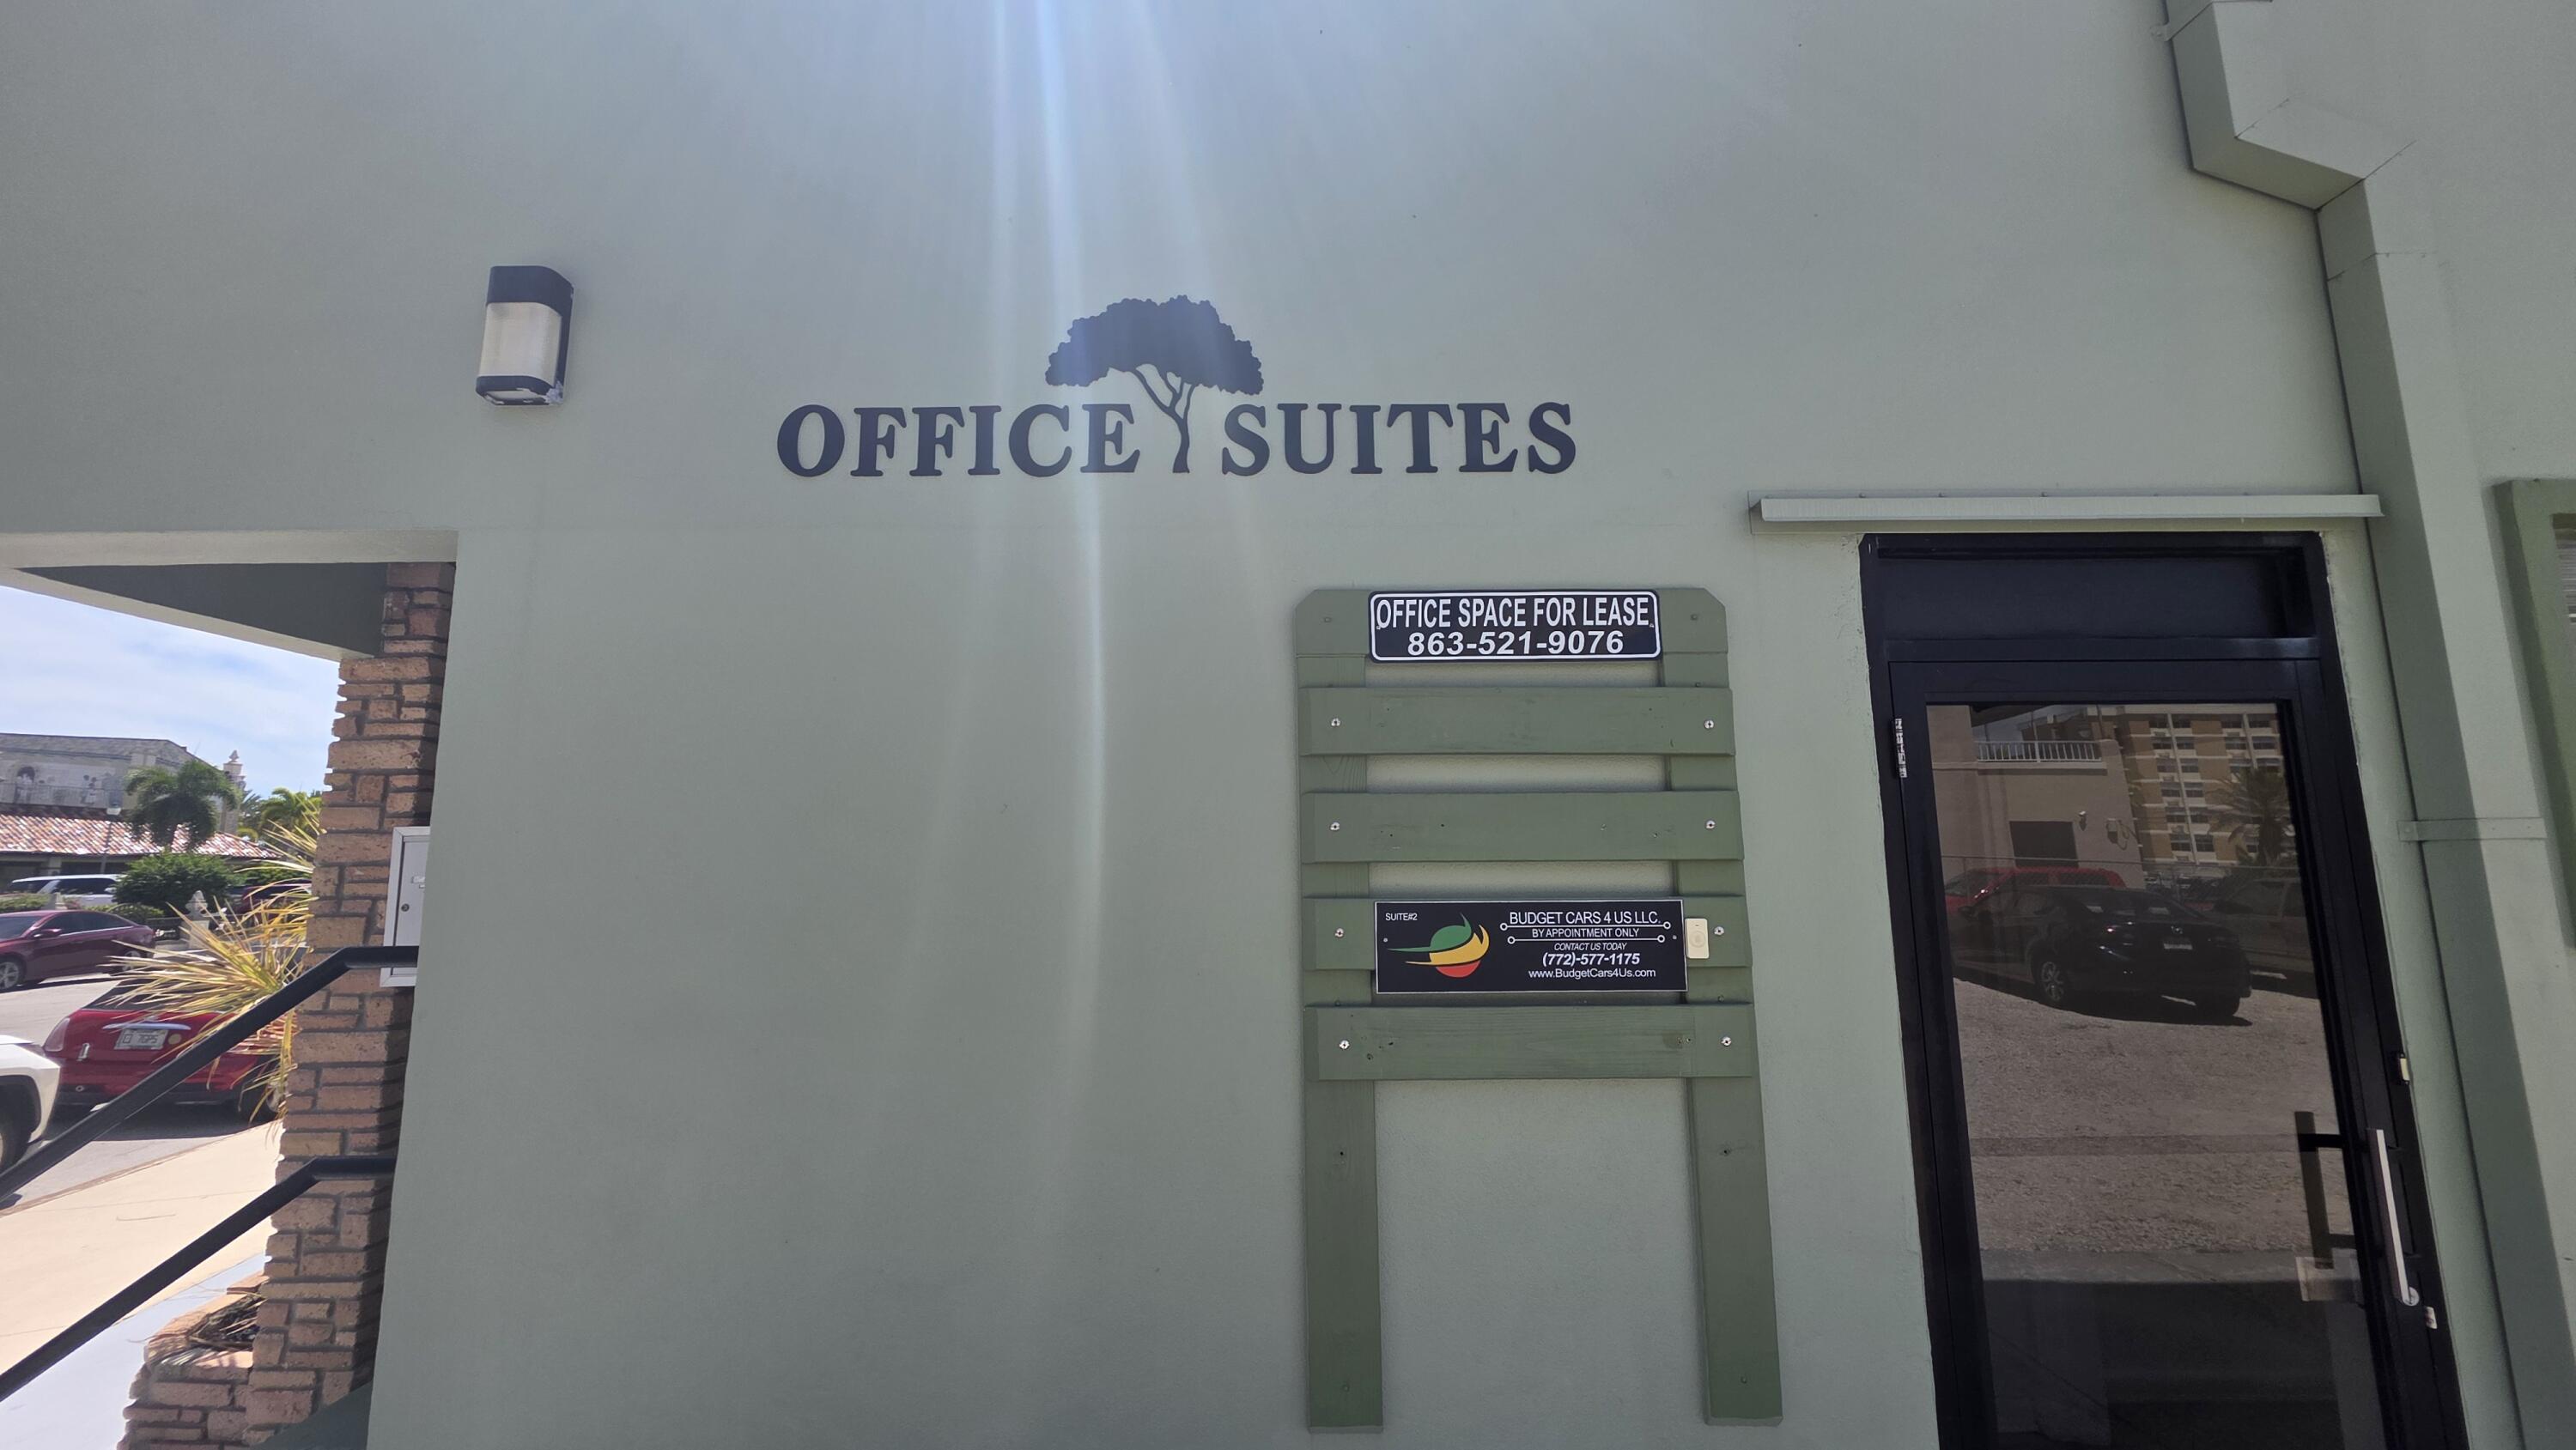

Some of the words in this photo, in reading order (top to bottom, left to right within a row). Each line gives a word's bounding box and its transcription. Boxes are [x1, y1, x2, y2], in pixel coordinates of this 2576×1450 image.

[777, 403, 1140, 477] OFFICE
[1222, 402, 1577, 476] SUITES
[1376, 598, 1451, 628] OFFICE
[1458, 598, 1527, 628] SPACE
[1534, 597, 1576, 627] FOR
[1583, 597, 1649, 626] LEASE
[1407, 630, 1624, 656] 863-521-9076
[1385, 913, 1418, 921] SUITE#2
[1510, 912, 1563, 925] BUDGET
[1565, 911, 1601, 925] CARS
[1603, 912, 1611, 924] 4
[1614, 911, 1631, 924] US
[1635, 911, 1662, 924] LLC.
[1532, 928, 1544, 937] BY
[1546, 928, 1613, 937] APPOINTMENT
[1614, 927, 1639, 937] ONLY
[1554, 943, 1589, 951] CONTACT
[1542, 952, 1641, 967] (772)-577-1175
[1528, 968, 1656, 980] www.BudgetCars4Us.com
